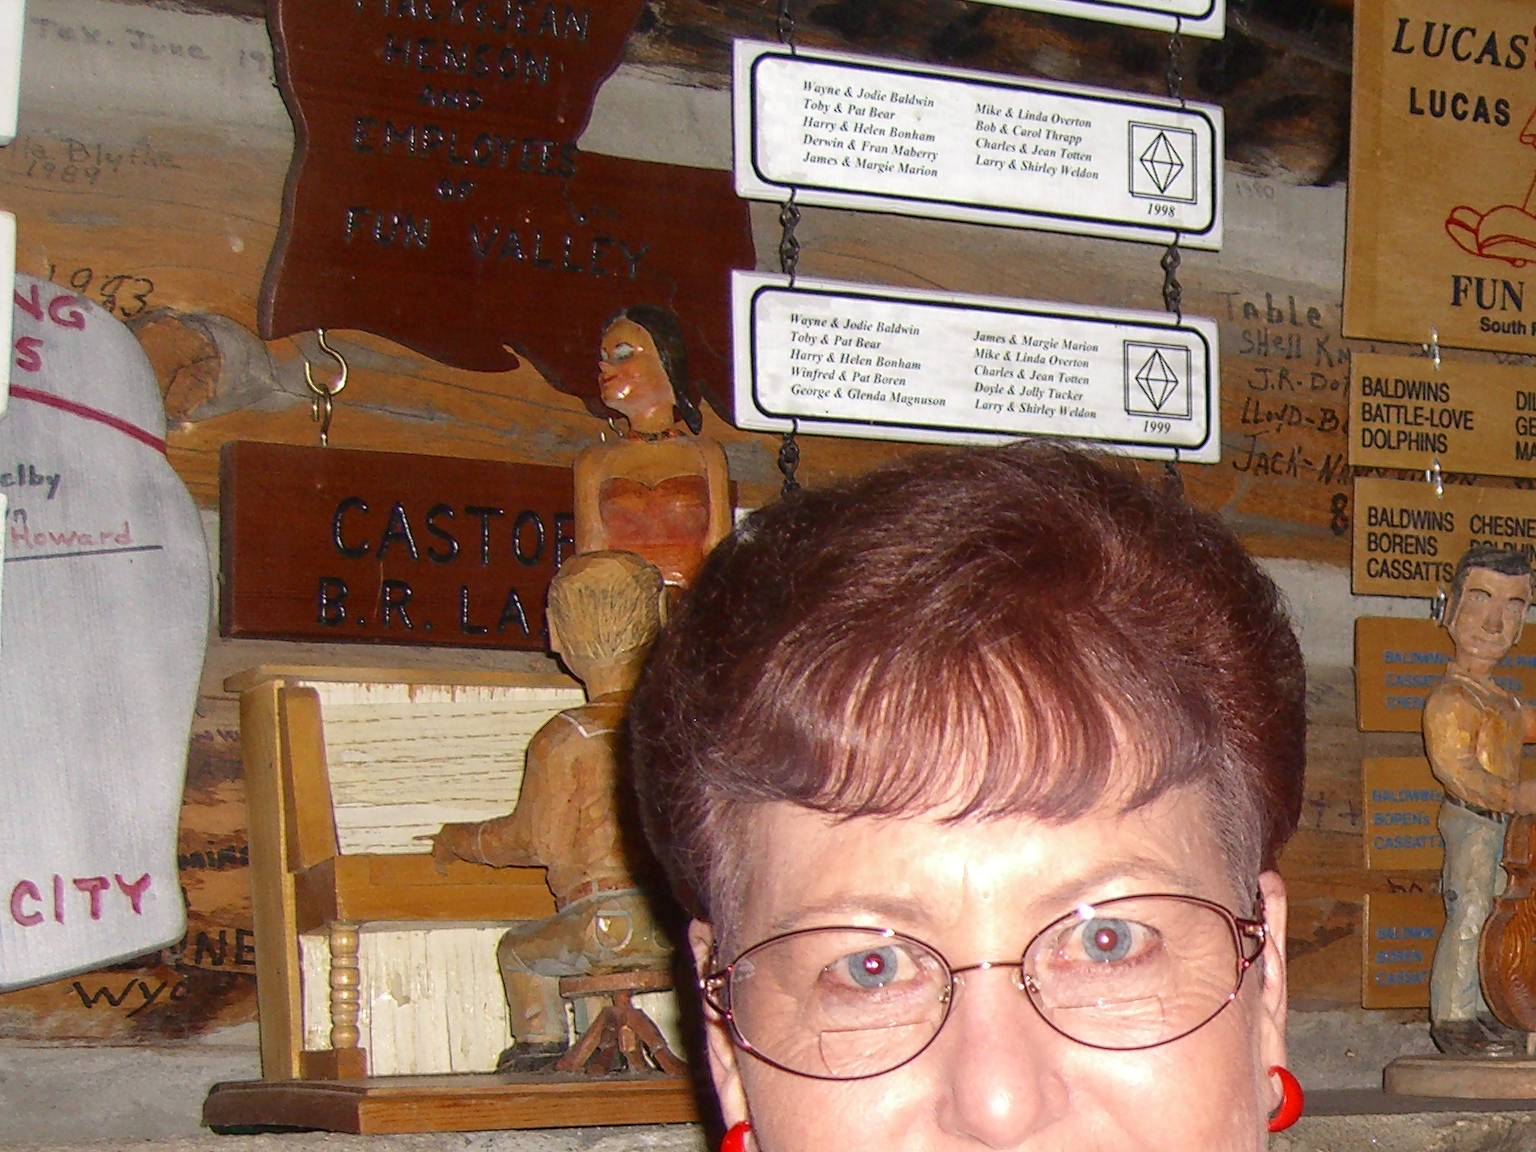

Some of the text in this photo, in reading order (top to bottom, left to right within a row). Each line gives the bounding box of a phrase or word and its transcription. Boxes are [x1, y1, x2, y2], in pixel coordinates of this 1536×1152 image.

[1392, 18, 1529, 69] LUCAS
[384, 33, 550, 85] HENSON
[420, 84, 484, 111] AND
[803, 81, 934, 108] Wayne & Jodie Baldwin
[1410, 87, 1510, 126] LUCAS
[803, 99, 895, 120] Toby & Pat Bear
[975, 103, 1091, 128] Mike & Linda Overton
[802, 116, 935, 142] Harry & Helen Bonham
[975, 121, 1082, 146] Bob & Carol Thrapp
[354, 117, 579, 179] EMPLOYEES
[803, 134, 938, 162] Derwin & Fran Maberry
[975, 138, 1092, 162] Charles & Jean Totten
[803, 152, 938, 177] James & Margie Marion
[975, 155, 1099, 180] Larry & Shirley Weldon
[1147, 203, 1175, 217] 1998
[344, 206, 650, 280] FUN VALLEY
[1451, 275, 1525, 311] FUN
[791, 313, 920, 336] Wayne & Jodie Baldwin
[1480, 316, 1526, 336] South
[791, 331, 882, 349] Toby & Pat Bear
[973, 330, 1099, 353] James & Margie Marion
[790, 349, 921, 370] Harry & Helen Bonham
[974, 348, 1089, 368] Mike & Linda Overton
[791, 366, 906, 386] Winfred & Pat Boren
[974, 365, 1089, 385] Charles & Jean Totten
[791, 384, 946, 406] George & Glenda Magnuson
[975, 382, 1083, 401] Doyle & Jolly Tucker
[1362, 376, 1450, 403] BALDWINS
[975, 399, 1096, 419] Larry & Shirley Weldon
[1362, 403, 1474, 430] BATTLE-LOVE
[1143, 420, 1171, 434] 1999
[1362, 428, 1448, 454] DOLPHINS
[1368, 507, 1455, 532] BALDWINS
[11, 521, 132, 548] Howard
[1368, 532, 1438, 557] BORENS
[1367, 558, 1453, 582] CASSATTS
[11, 873, 151, 927] CITY
